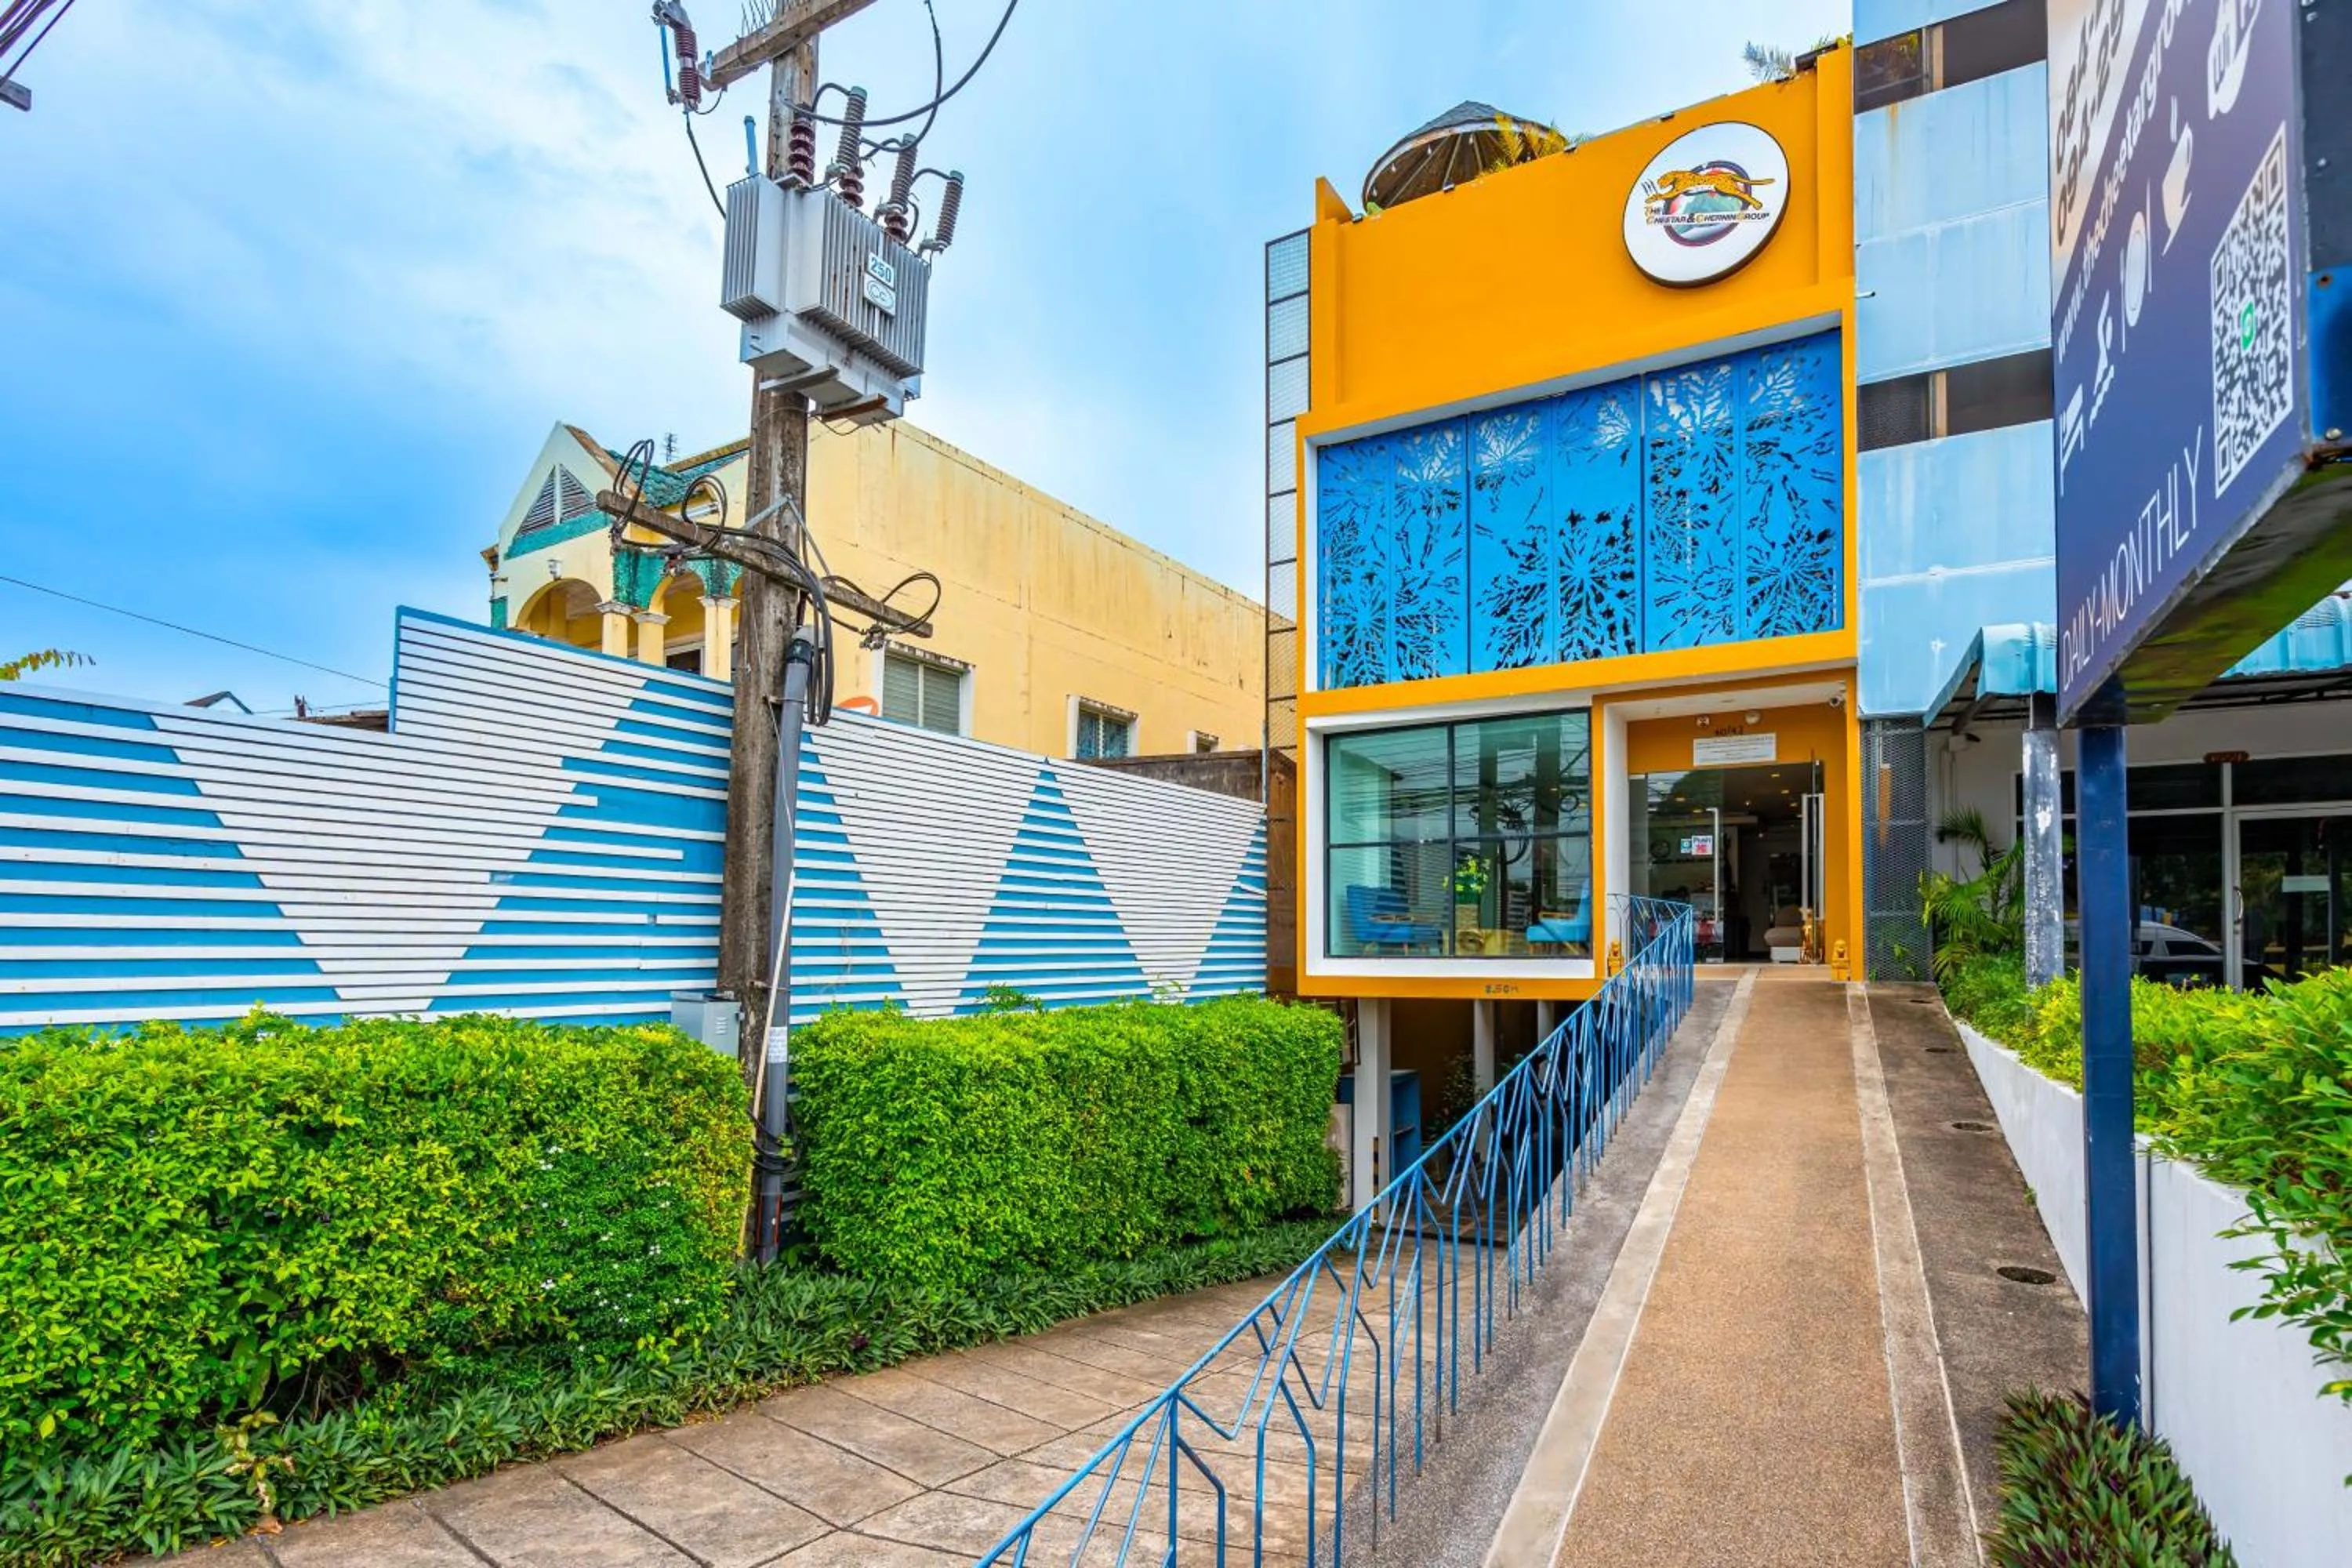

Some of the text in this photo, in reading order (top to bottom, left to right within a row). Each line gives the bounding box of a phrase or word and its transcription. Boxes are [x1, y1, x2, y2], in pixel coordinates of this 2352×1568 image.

[871, 256, 891, 283] 250
[2058, 0, 2193, 364] www.thecheetargro
[2063, 425, 2202, 692] DAILY-MONTHLY
